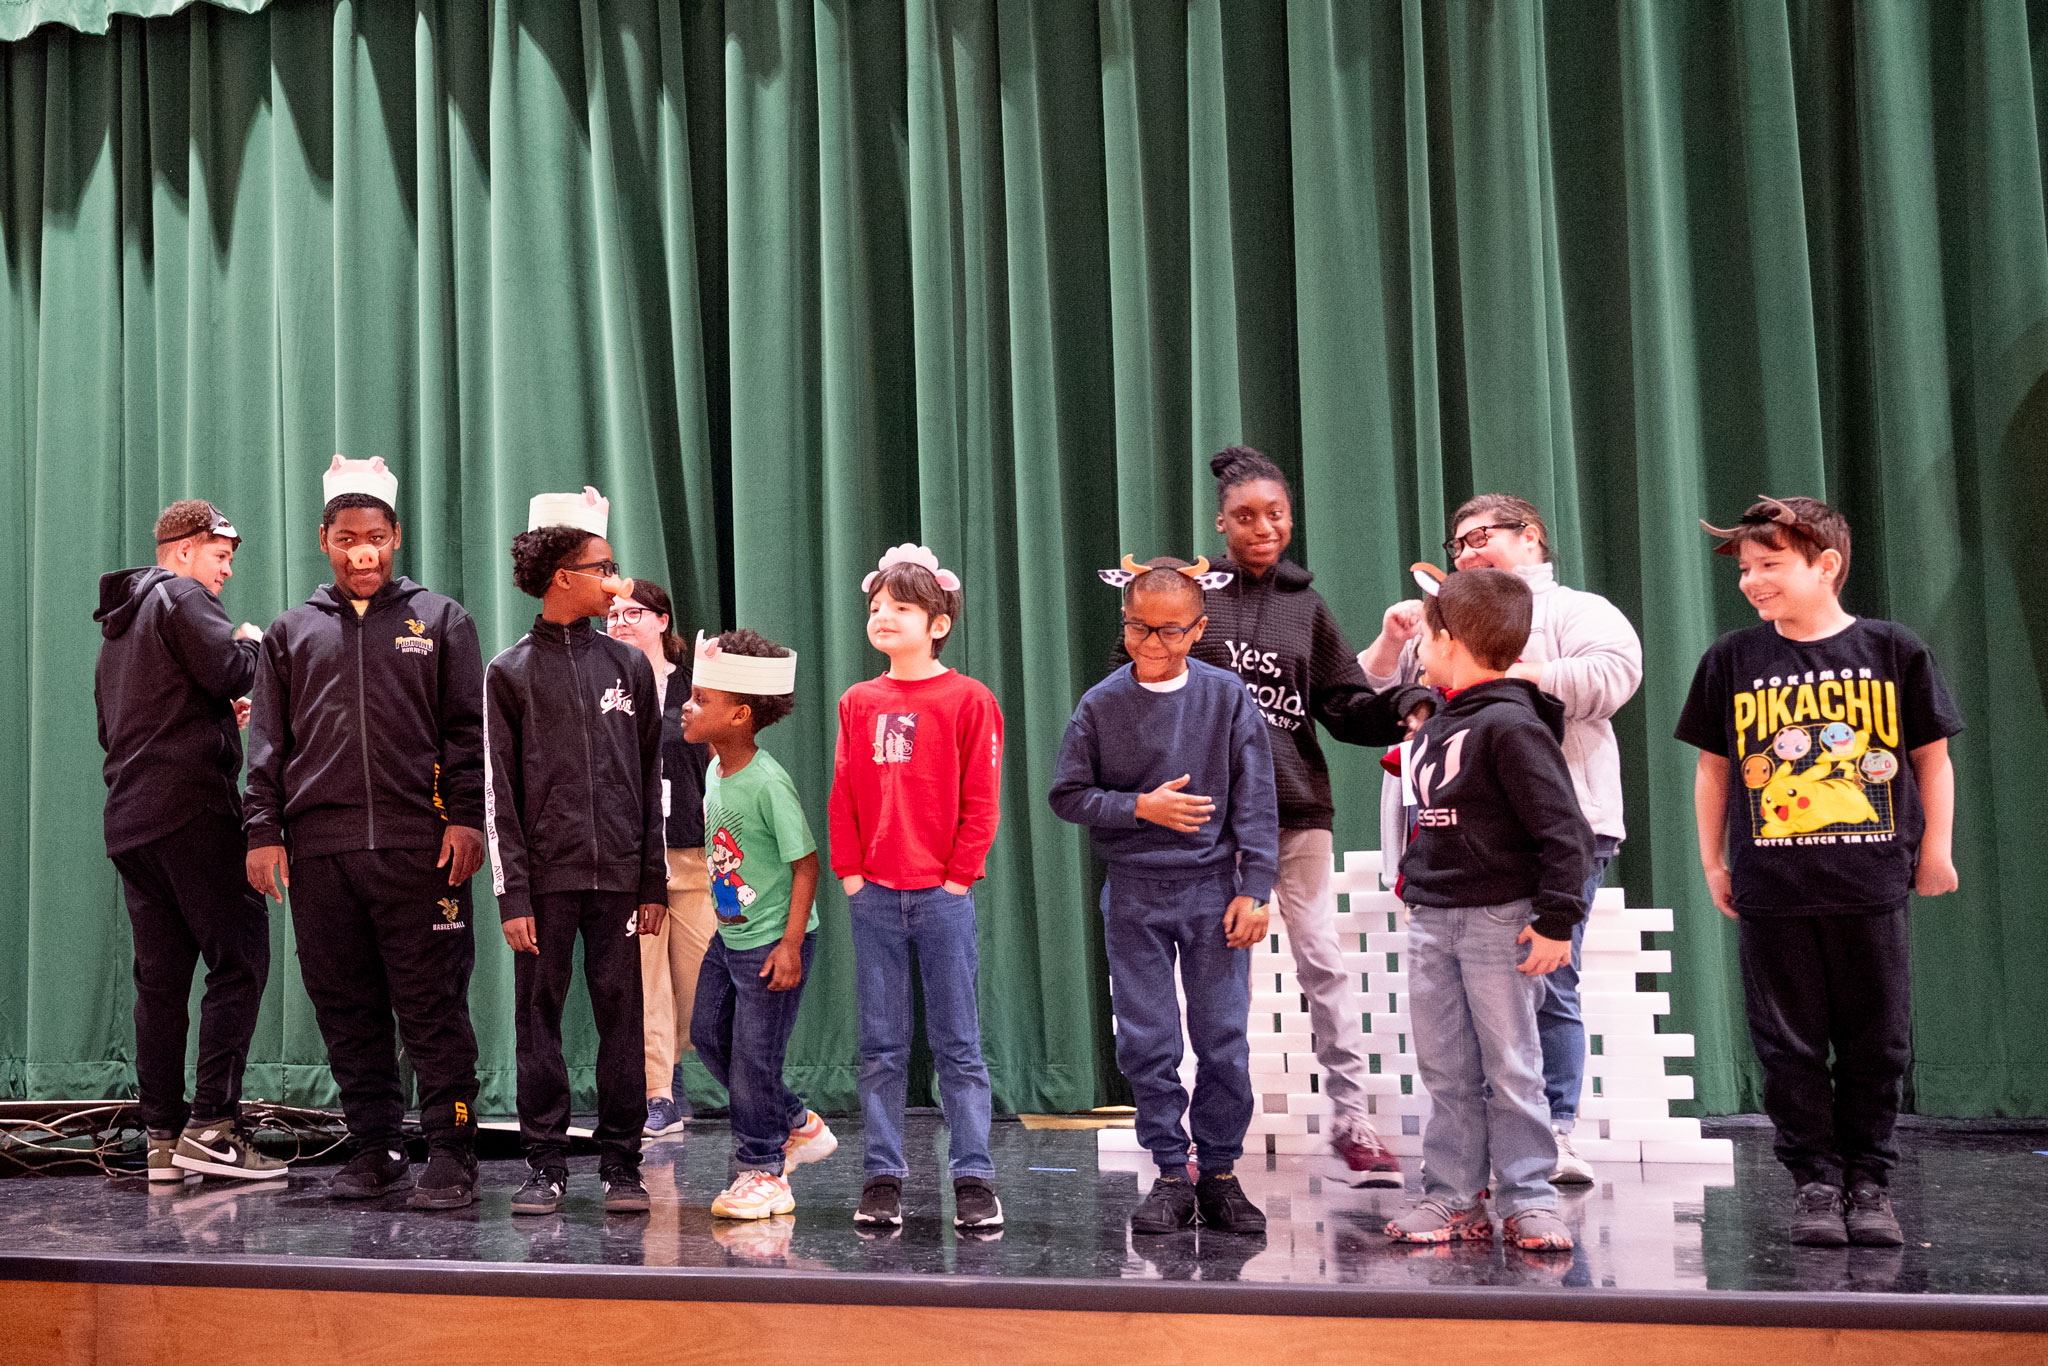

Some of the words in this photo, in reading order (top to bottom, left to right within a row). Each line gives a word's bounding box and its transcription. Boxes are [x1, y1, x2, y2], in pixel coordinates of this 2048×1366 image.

[1225, 641, 1282, 678] Yes,
[1734, 679, 1899, 760] PIKACHU
[1754, 837, 1793, 847] GOTTA
[1796, 834, 1837, 846] CATCH
